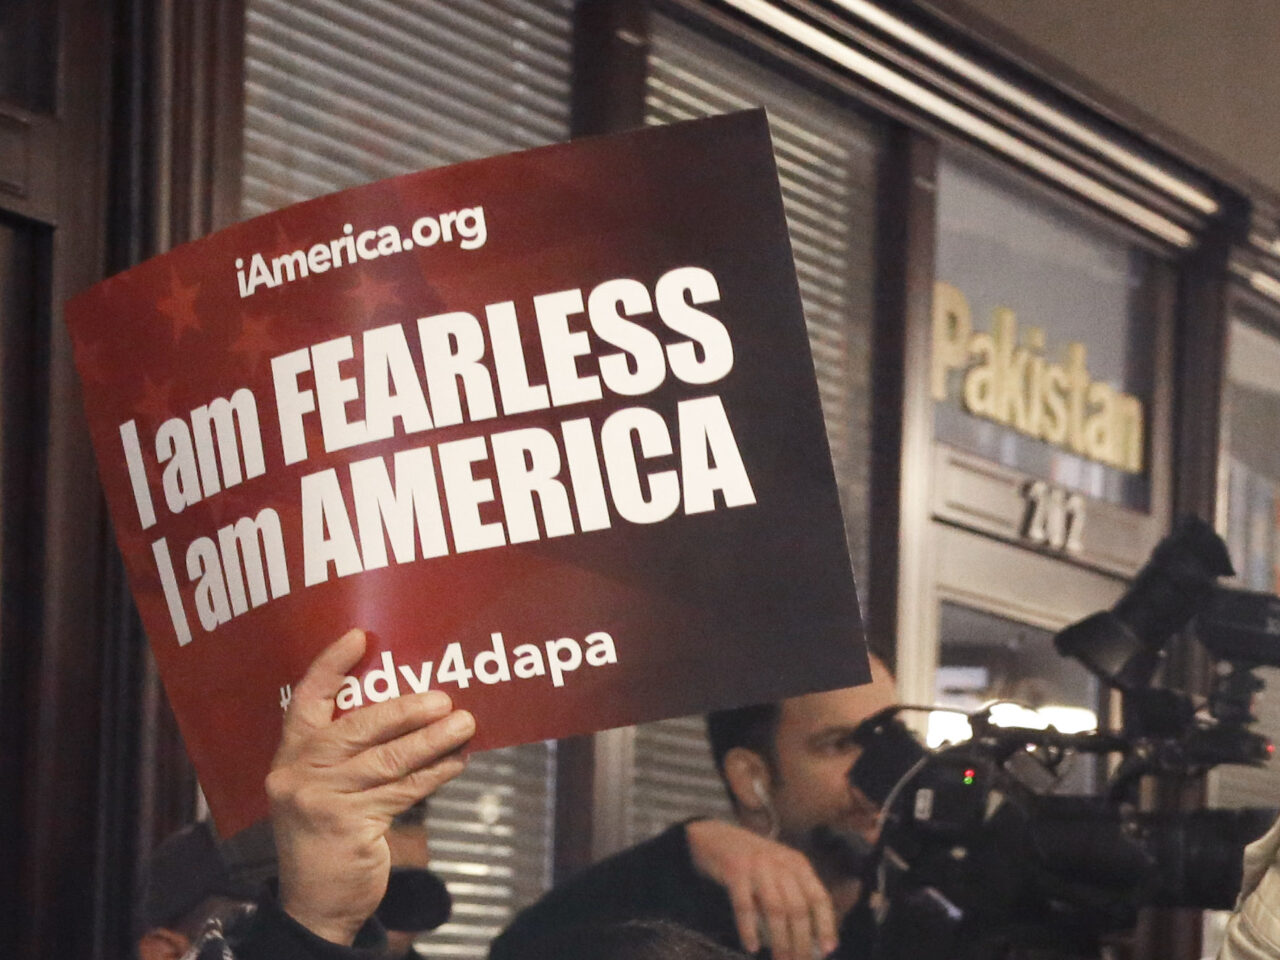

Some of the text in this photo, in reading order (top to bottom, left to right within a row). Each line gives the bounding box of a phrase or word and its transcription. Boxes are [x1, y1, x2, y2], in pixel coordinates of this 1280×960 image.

[234, 206, 488, 299] iAmerica.org
[118, 265, 735, 531] I am FEARLESS
[930, 280, 1144, 475] Pakistan
[150, 395, 757, 648] I am AMERICA
